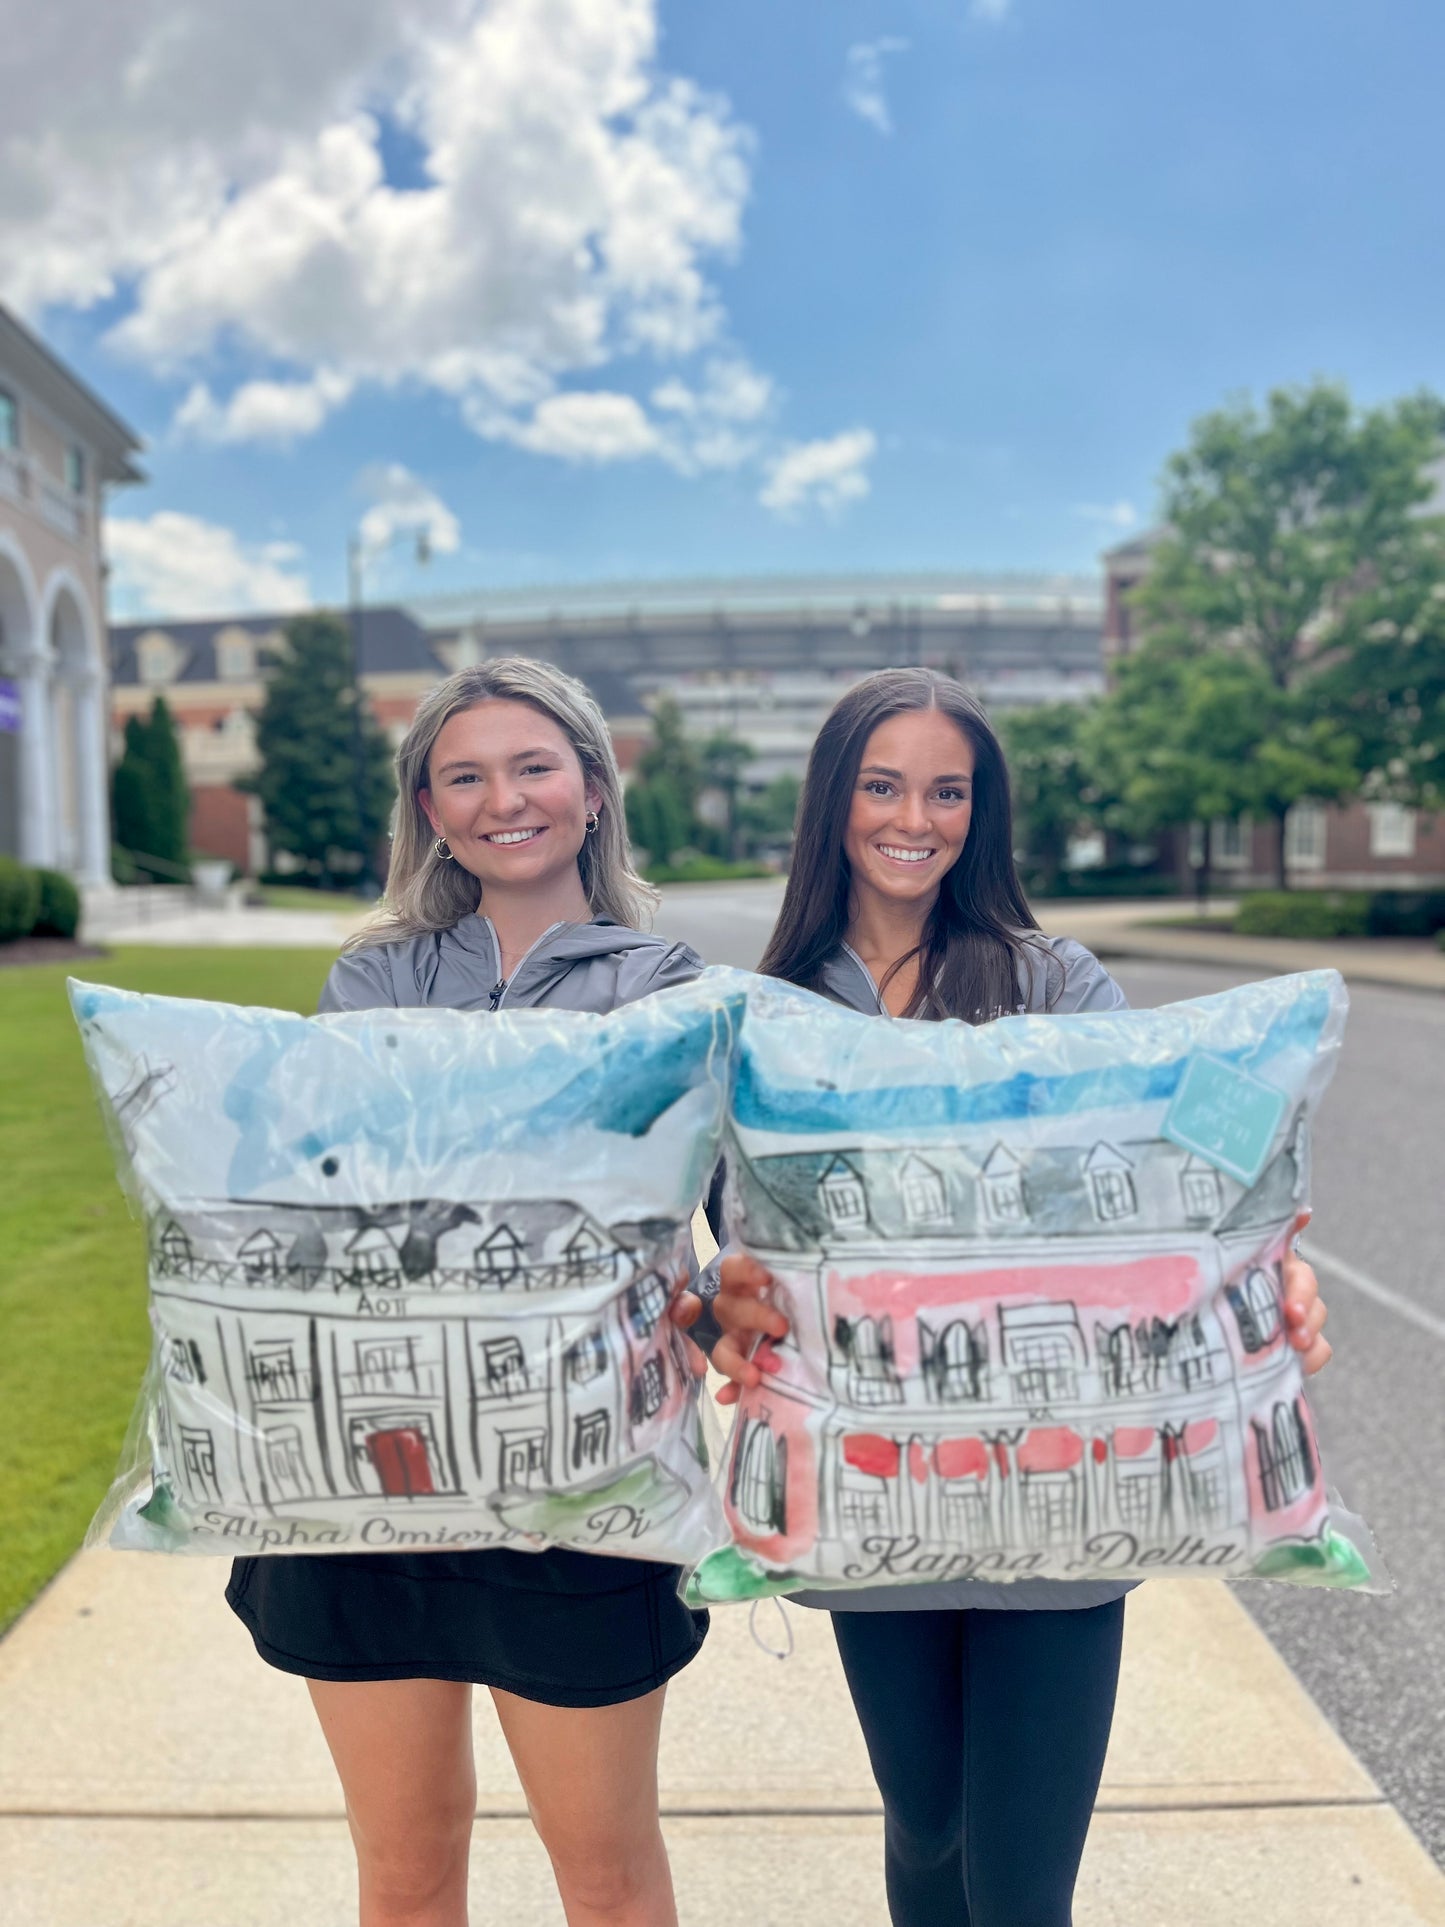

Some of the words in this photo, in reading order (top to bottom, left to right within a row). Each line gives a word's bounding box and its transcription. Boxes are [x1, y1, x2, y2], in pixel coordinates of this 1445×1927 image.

[193, 1510, 349, 1551] Alpha
[571, 1504, 651, 1545] Pi
[843, 1533, 1051, 1580] Kappa
[1064, 1531, 1244, 1571] Delta
